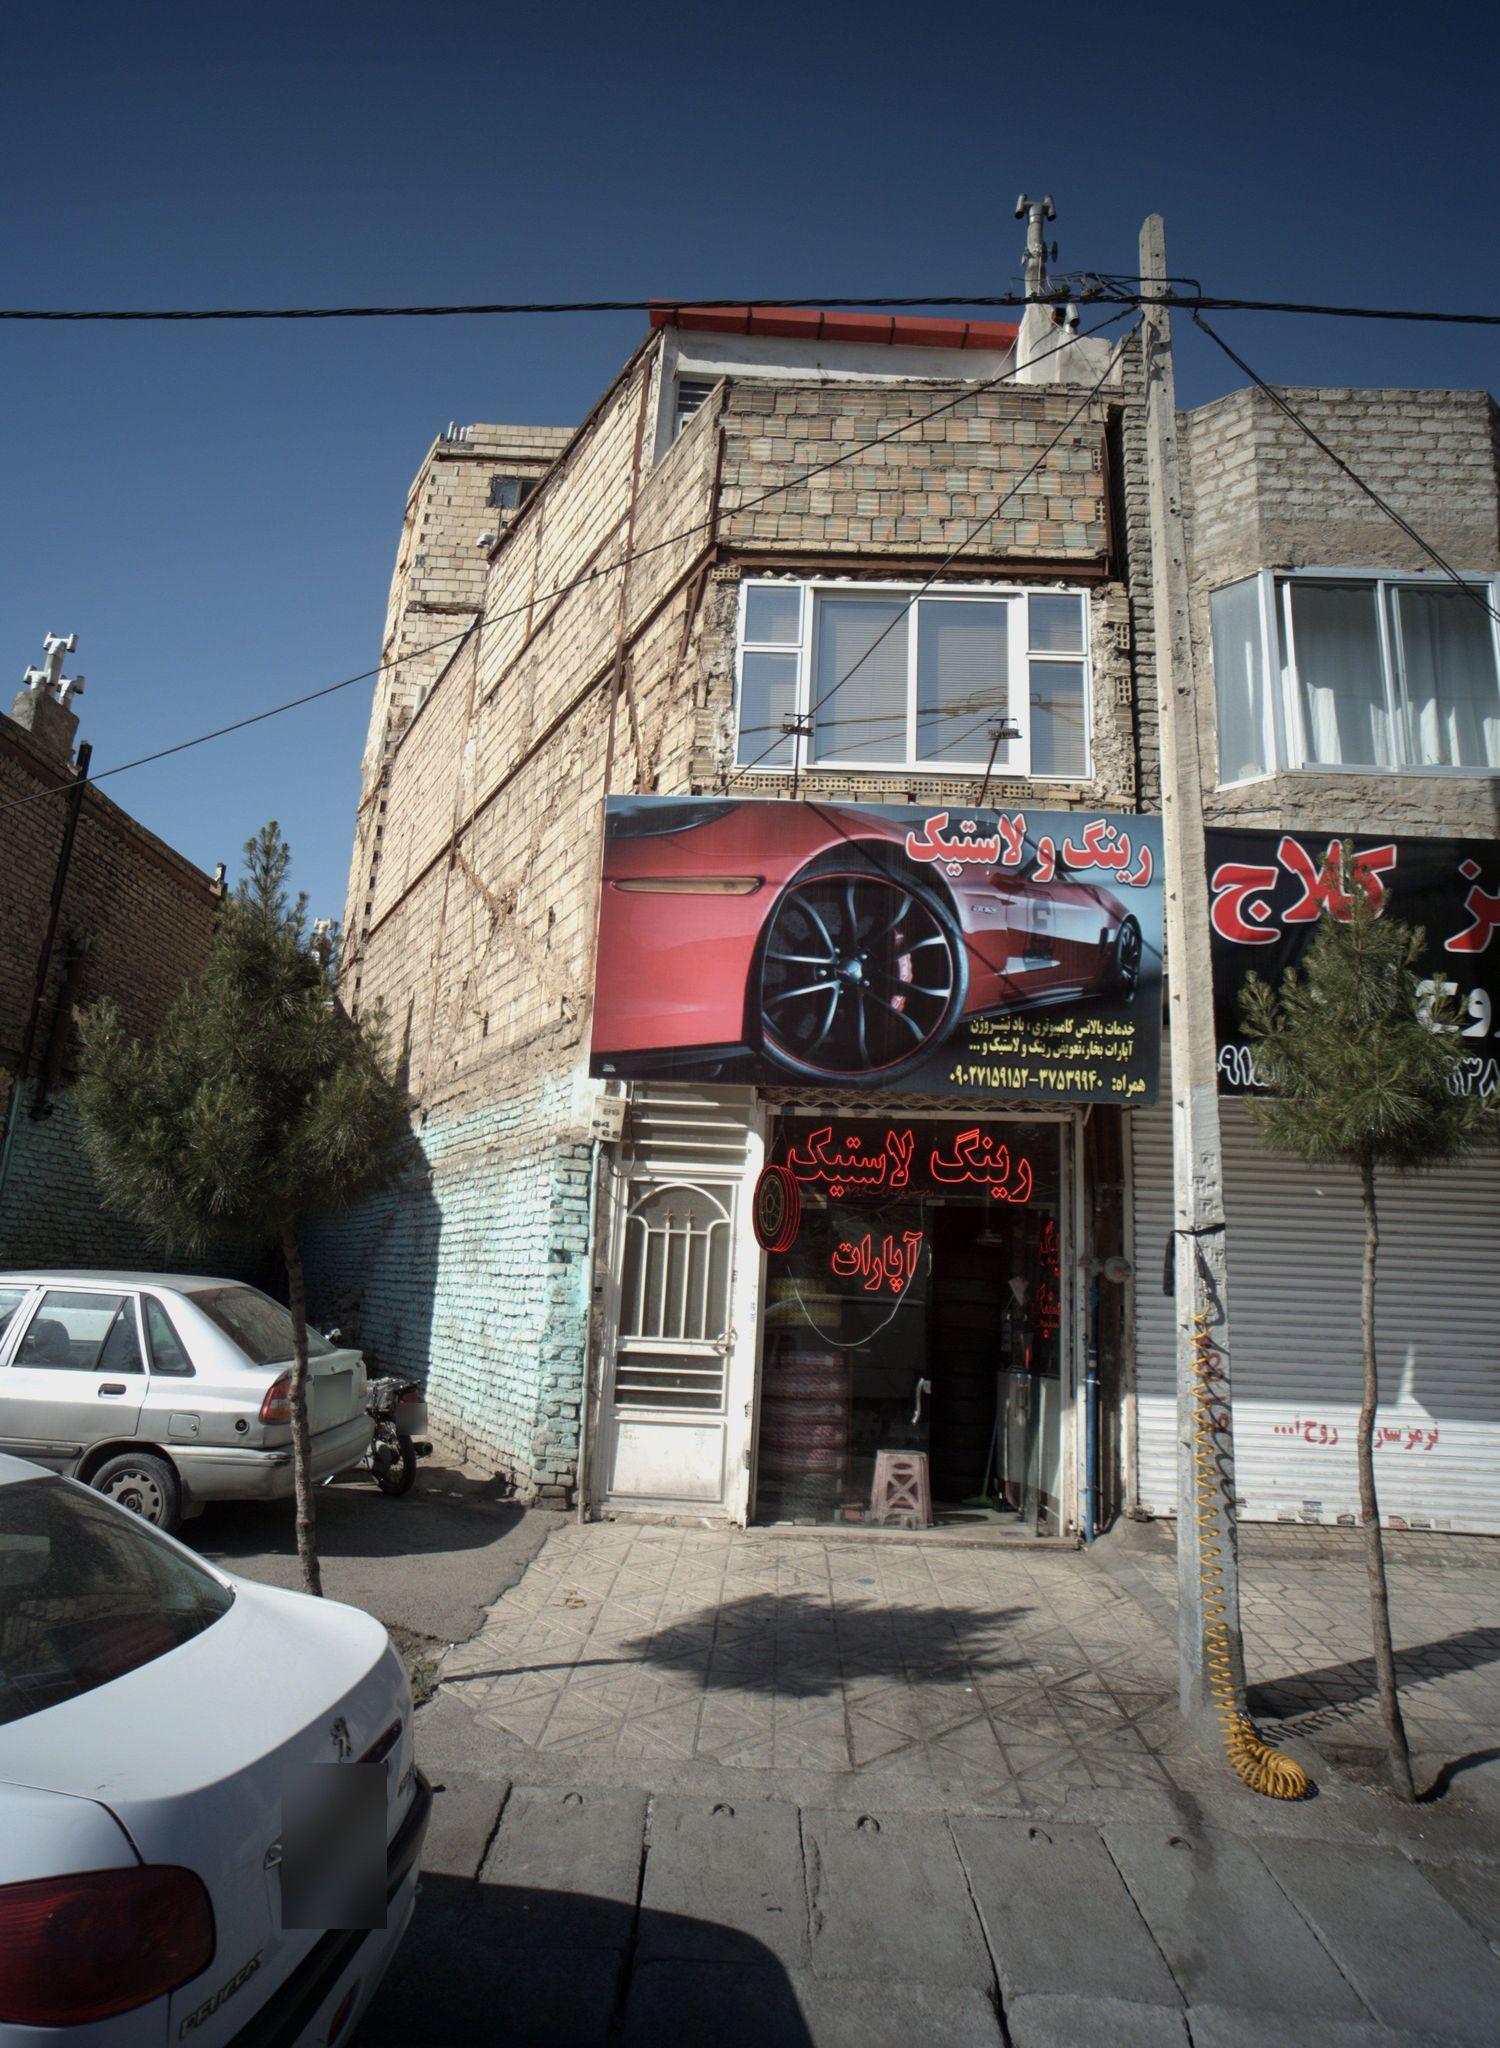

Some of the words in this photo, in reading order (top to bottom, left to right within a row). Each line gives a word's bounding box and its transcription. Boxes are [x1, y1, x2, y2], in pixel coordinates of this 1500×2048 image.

[905, 811, 1028, 878] لاستیک
[1062, 818, 1153, 888] رینگ
[1030, 836, 1056, 883] و
[1012, 1017, 1025, 1035] باد
[1075, 1018, 1104, 1039] بالانس
[1104, 1020, 1136, 1036] خدمات
[981, 1041, 989, 1056] و
[989, 1036, 1020, 1056] لاستیک
[1020, 1042, 1028, 1058] و
[1104, 1039, 1134, 1063] آپارات
[1110, 1072, 1147, 1098] همراه:
[787, 1126, 915, 1198] لاستیک
[930, 1127, 1033, 1203] رینگ
[831, 1230, 924, 1293] آپارات
[1303, 1420, 1339, 1446] روح
